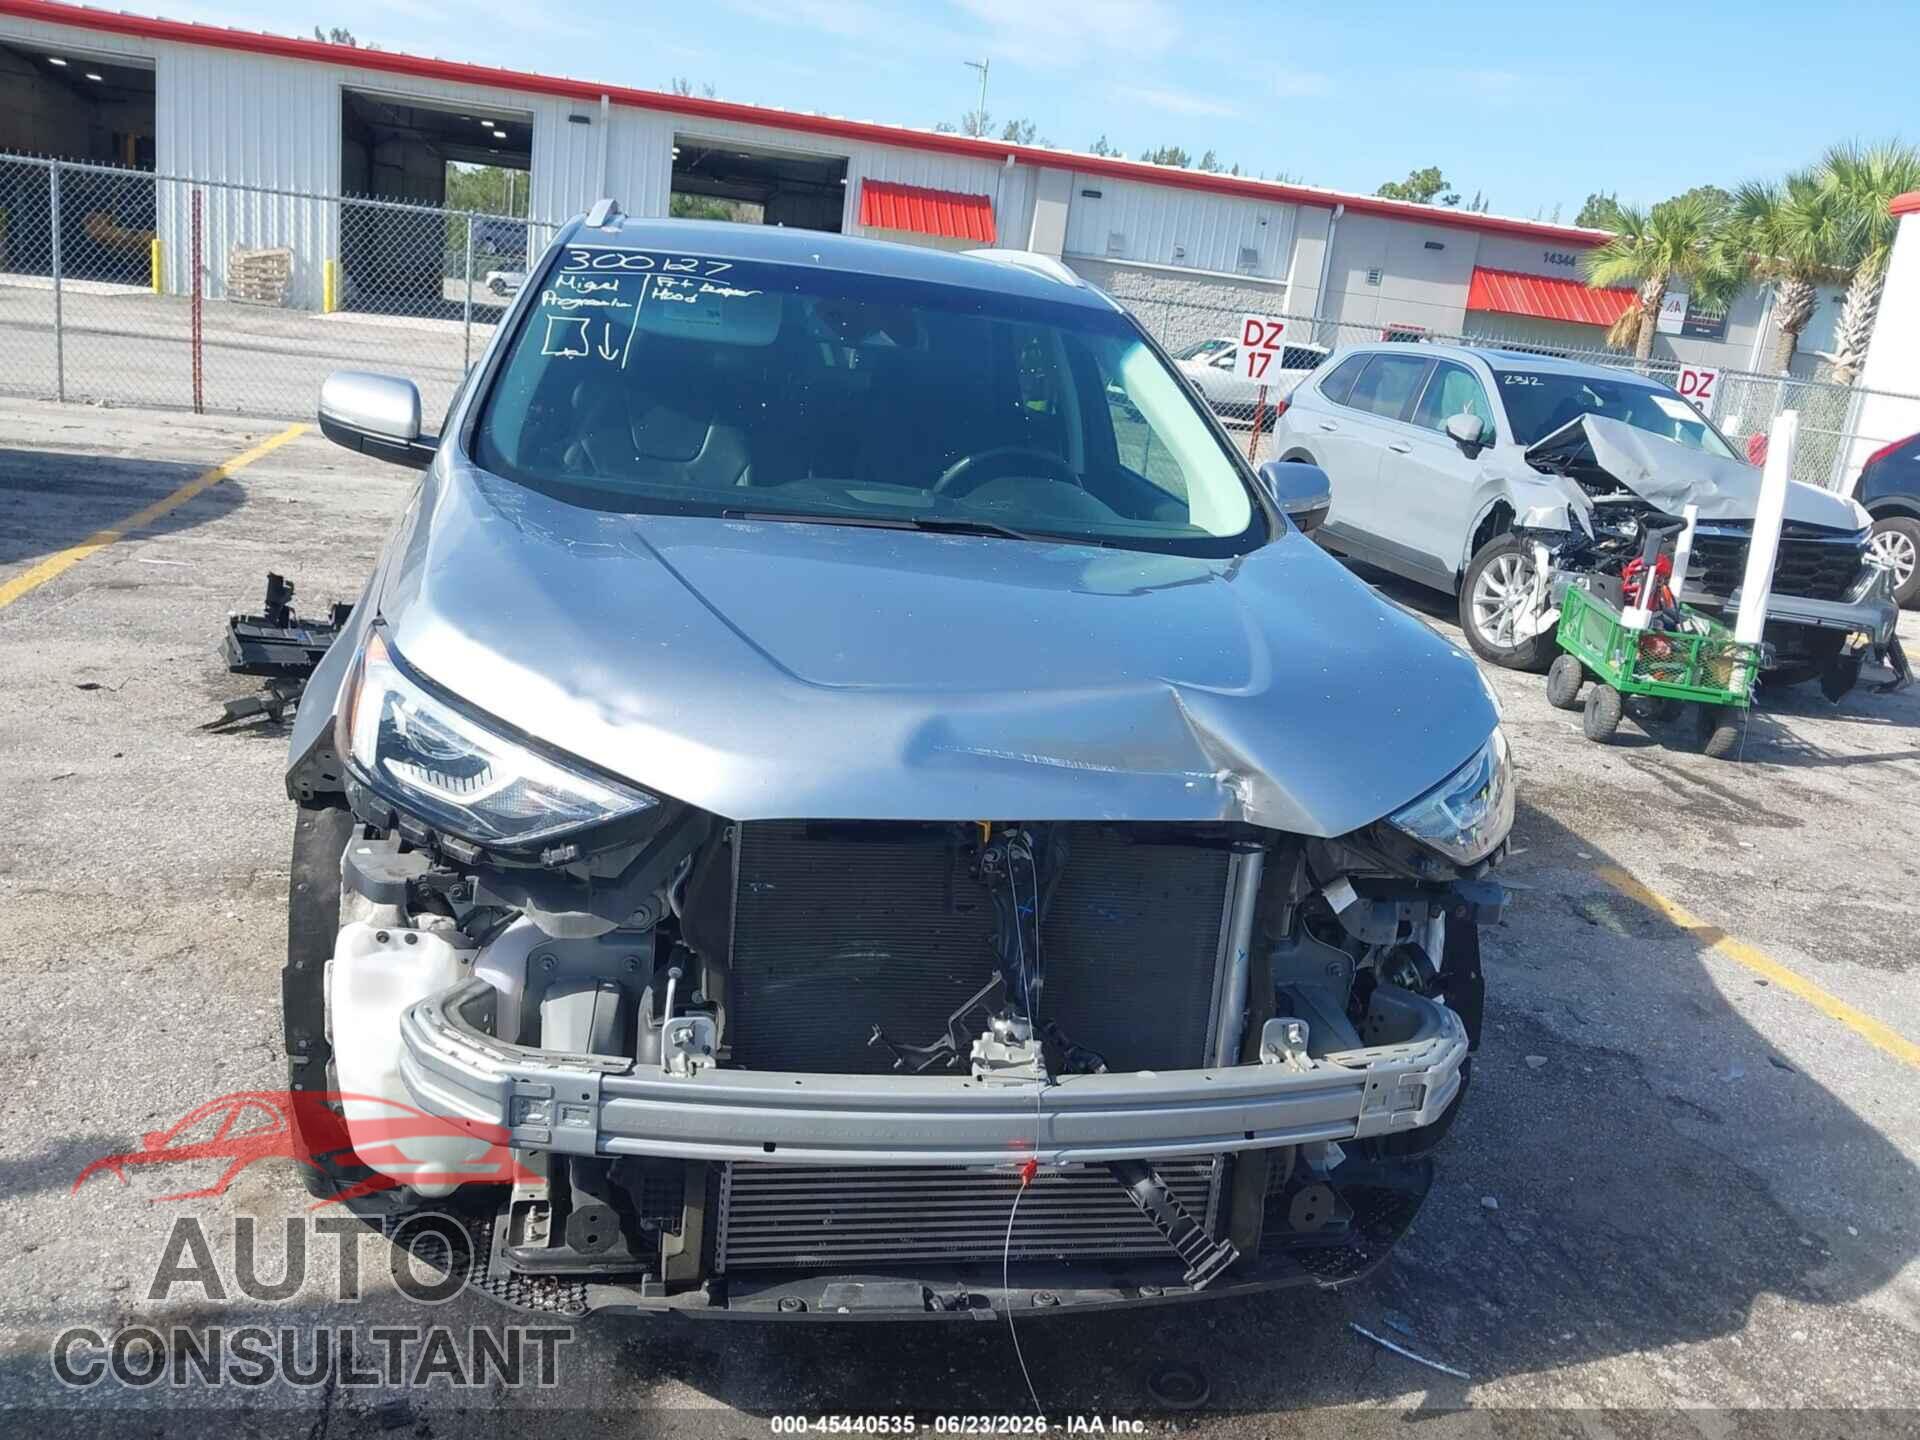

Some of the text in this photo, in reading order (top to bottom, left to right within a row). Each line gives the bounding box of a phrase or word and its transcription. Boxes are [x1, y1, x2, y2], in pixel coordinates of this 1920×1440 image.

[1243, 320, 1284, 350] DZ
[1248, 352, 1271, 378] 17
[1680, 370, 1714, 398] DZ
